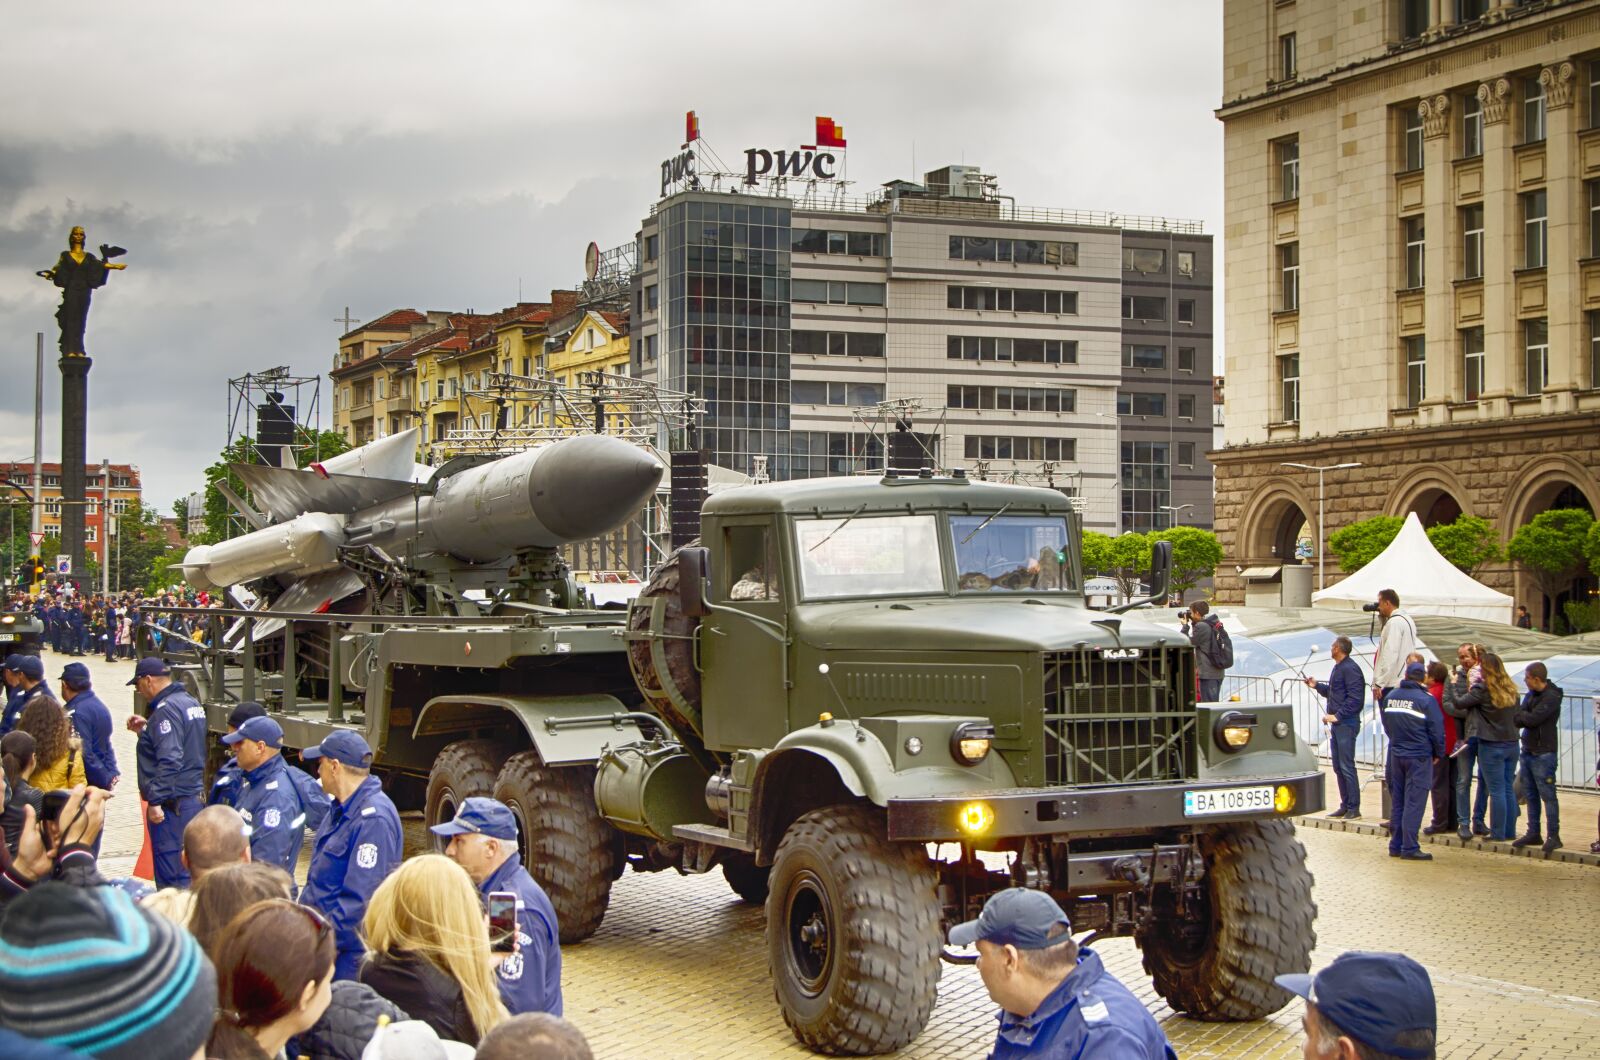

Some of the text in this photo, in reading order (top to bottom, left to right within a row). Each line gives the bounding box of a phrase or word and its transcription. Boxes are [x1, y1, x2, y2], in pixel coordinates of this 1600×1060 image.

[661, 150, 695, 197] pwc
[744, 148, 835, 185] pwc
[1387, 699, 1413, 710] POLICE
[1197, 790, 1271, 811] BA 108958
